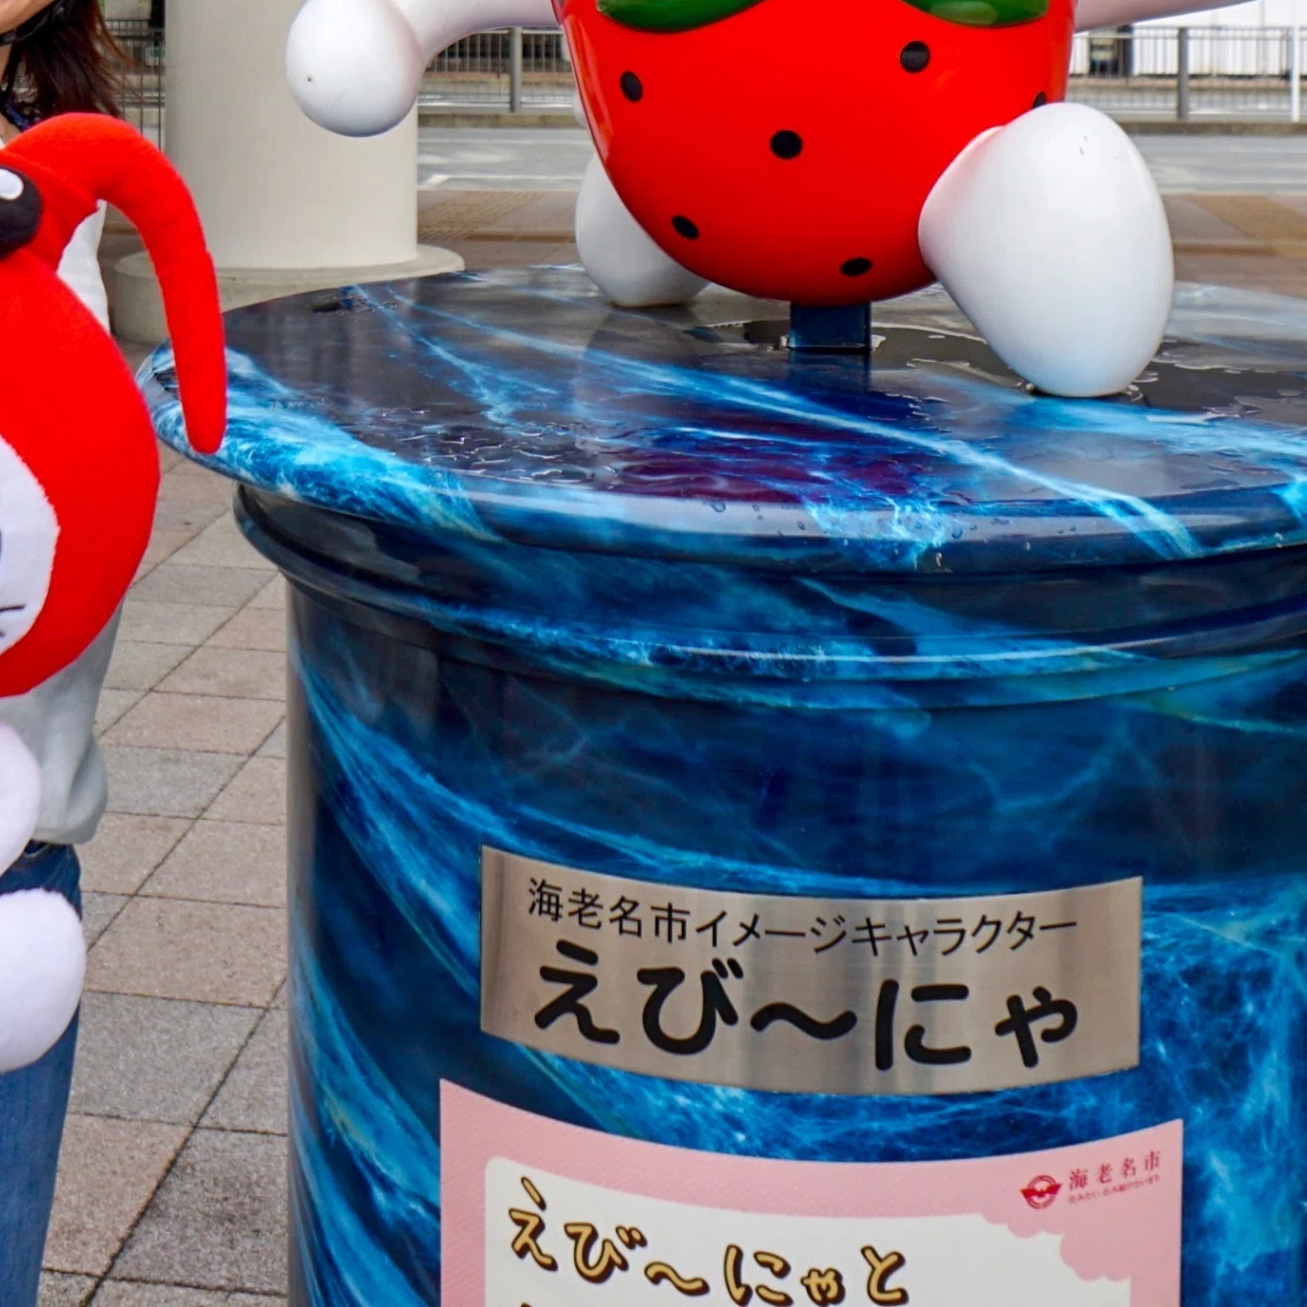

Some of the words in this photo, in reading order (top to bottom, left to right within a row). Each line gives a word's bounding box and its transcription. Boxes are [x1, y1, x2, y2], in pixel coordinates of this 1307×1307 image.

[527, 877, 1079, 958] 海老名市イメージキャラクター
[533, 939, 1079, 1072] えび〜にゃ
[1068, 1150, 1161, 1191] 海老名市
[508, 1176, 909, 1307] えび〜にゃと
